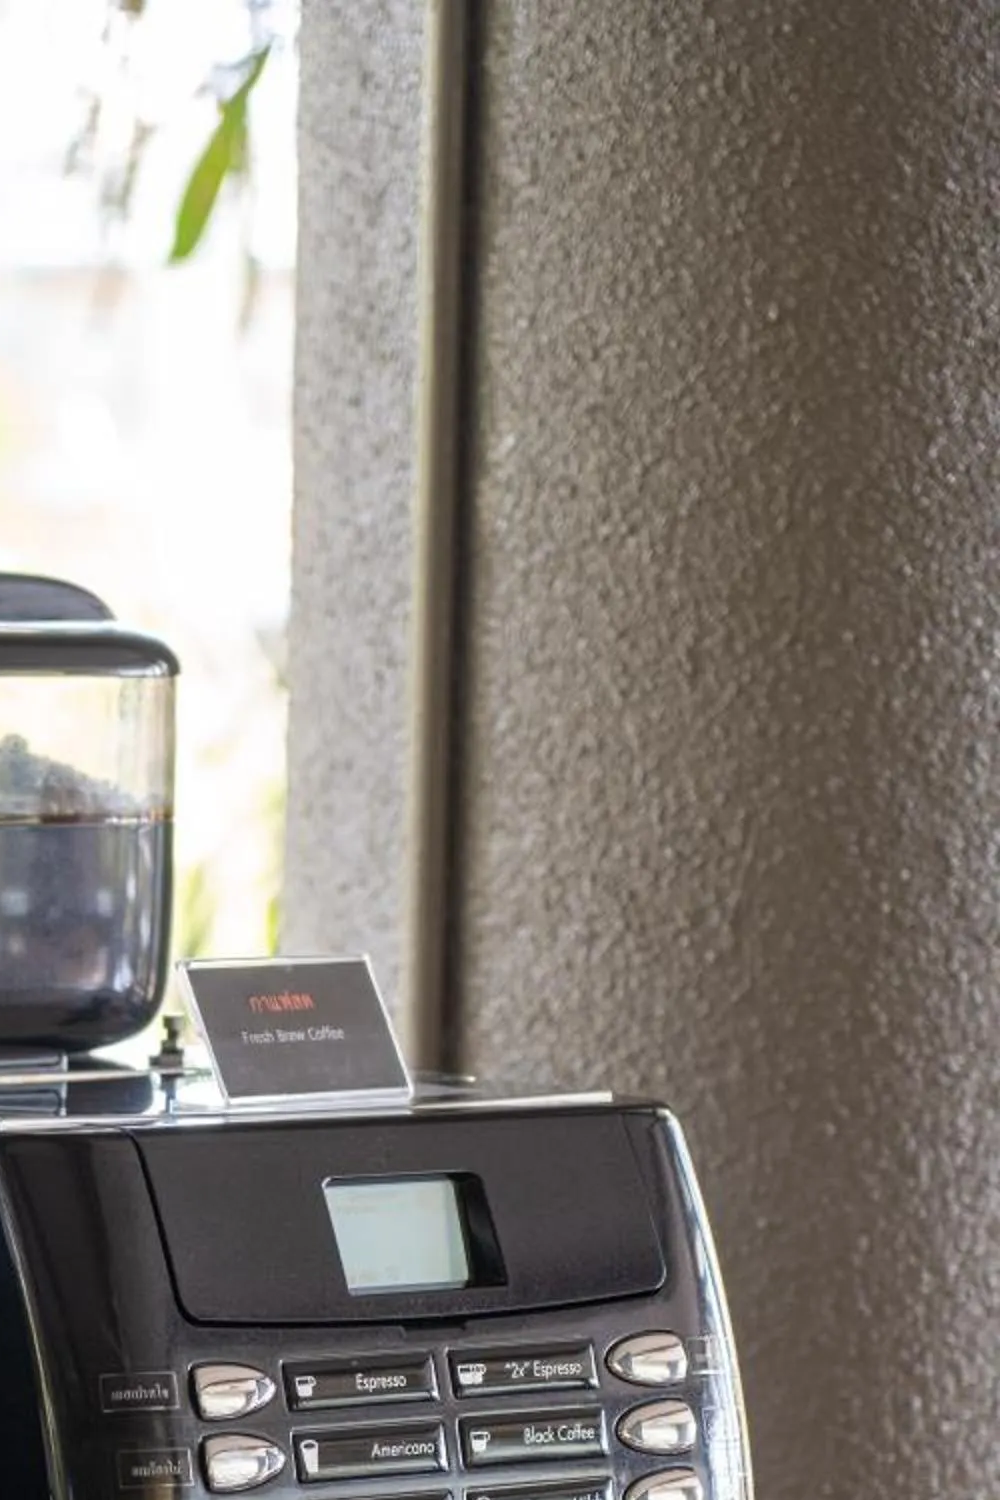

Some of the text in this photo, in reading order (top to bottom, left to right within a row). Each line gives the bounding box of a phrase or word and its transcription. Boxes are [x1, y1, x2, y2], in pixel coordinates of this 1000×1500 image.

[241, 1025, 345, 1045] Fresh Brew Coffee
[533, 1360, 583, 1380] Espresso
[355, 1373, 407, 1393] Espresso
[523, 1423, 596, 1444] Black Coffee
[371, 1442, 435, 1458] Americano
